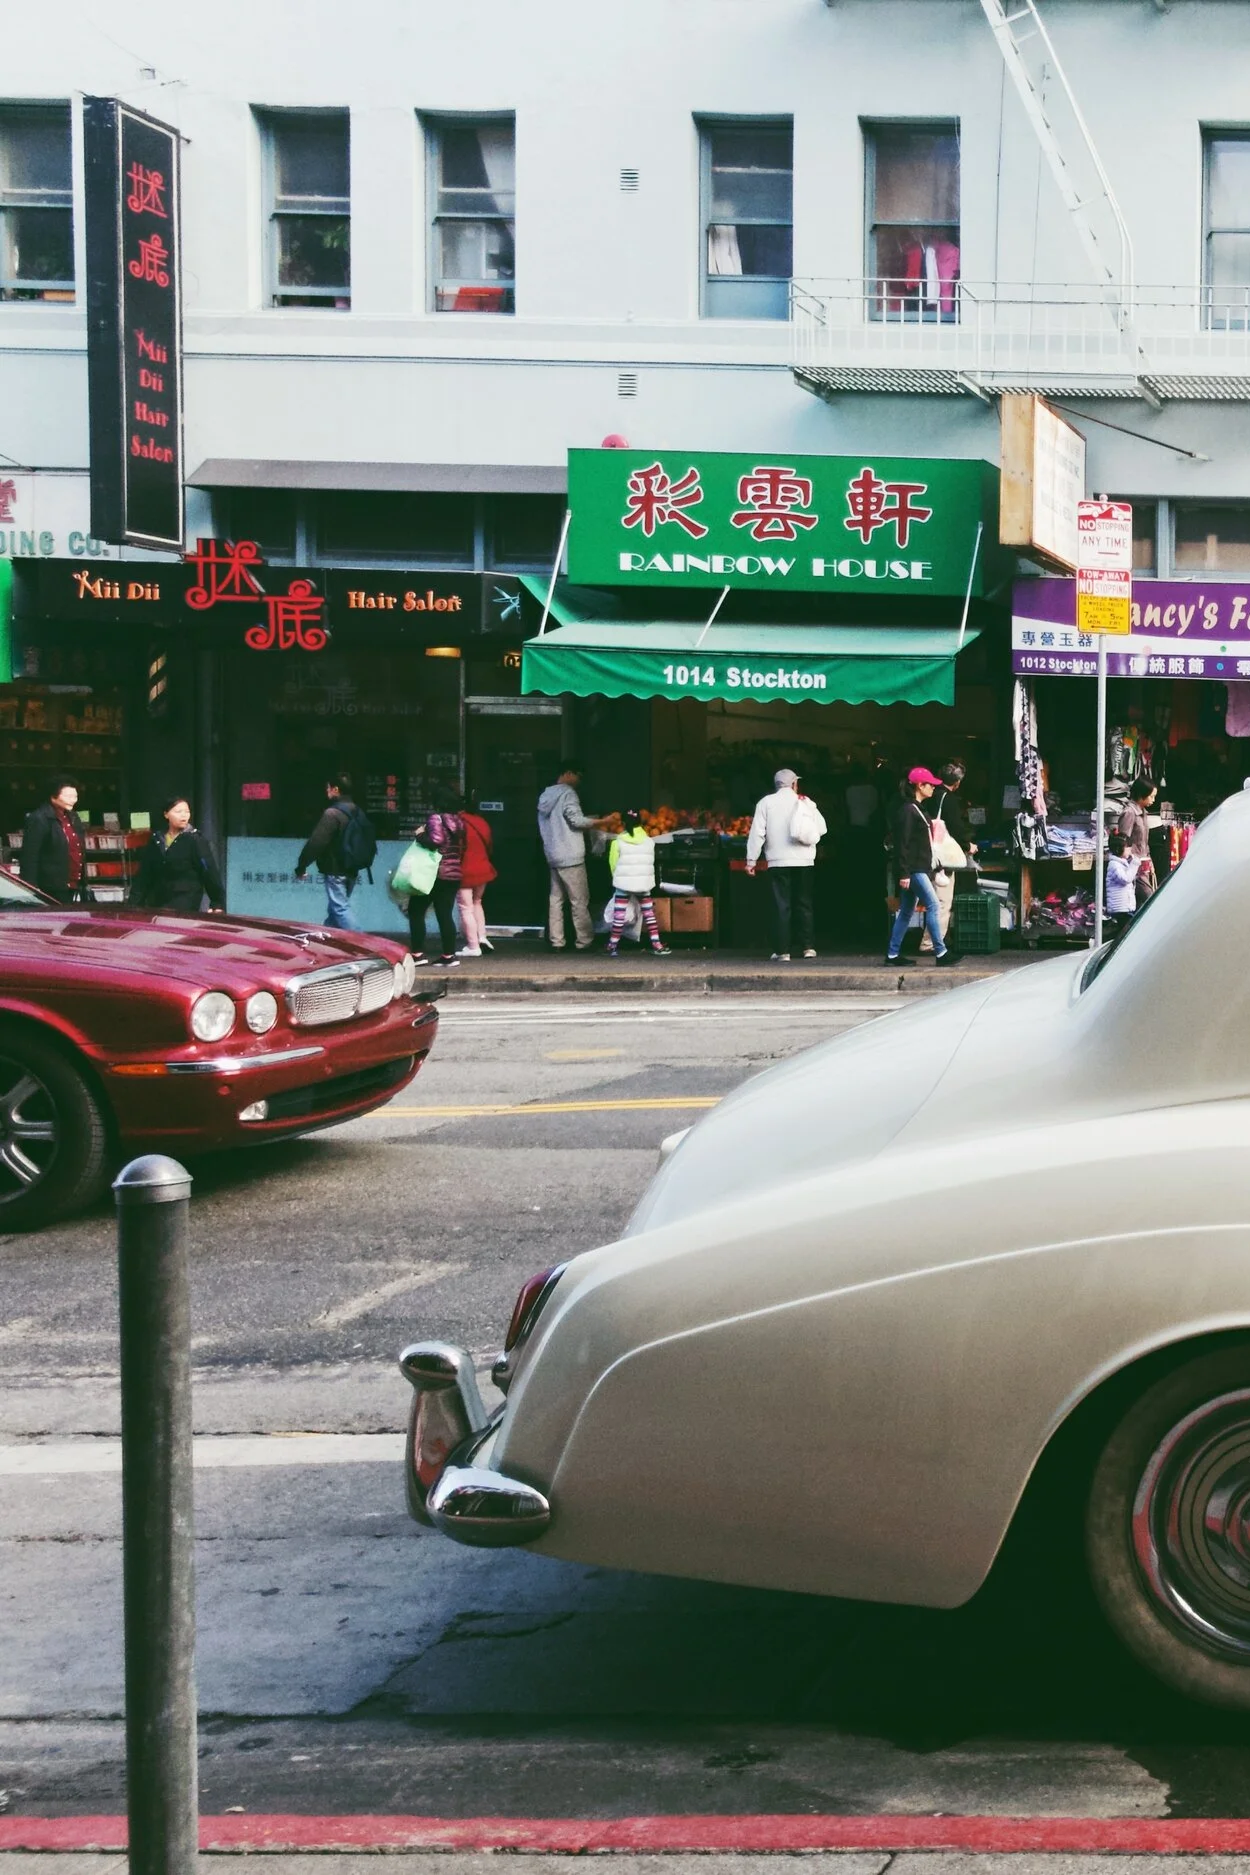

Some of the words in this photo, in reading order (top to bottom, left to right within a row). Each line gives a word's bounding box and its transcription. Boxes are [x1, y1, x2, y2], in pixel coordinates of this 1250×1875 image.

[134, 328, 168, 364] Mii
[140, 368, 164, 392] Dii
[135, 401, 169, 427] Hair
[131, 435, 173, 462] Salon
[621, 461, 933, 548] 彩雲軒
[1080, 519, 1096, 530] NO
[1097, 522, 1130, 532] STOPPING
[1082, 536, 1101, 547] ANY
[1105, 536, 1128, 549] TIME
[619, 552, 796, 576] RAINBOW
[812, 558, 933, 580] HOUSE
[1082, 570, 1126, 581] TOW-AWAY
[72, 570, 120, 599] Mii
[127, 583, 161, 600] Dii
[1079, 579, 1093, 594] NO
[1095, 582, 1128, 595] STOPPING
[348, 591, 397, 610] Hair
[403, 590, 462, 612] Salon
[1131, 595, 1218, 636] ancy's
[1020, 656, 1047, 669] 1012
[1048, 657, 1097, 671] Stockton
[662, 665, 716, 686] 1014
[726, 667, 827, 689] Stockton
